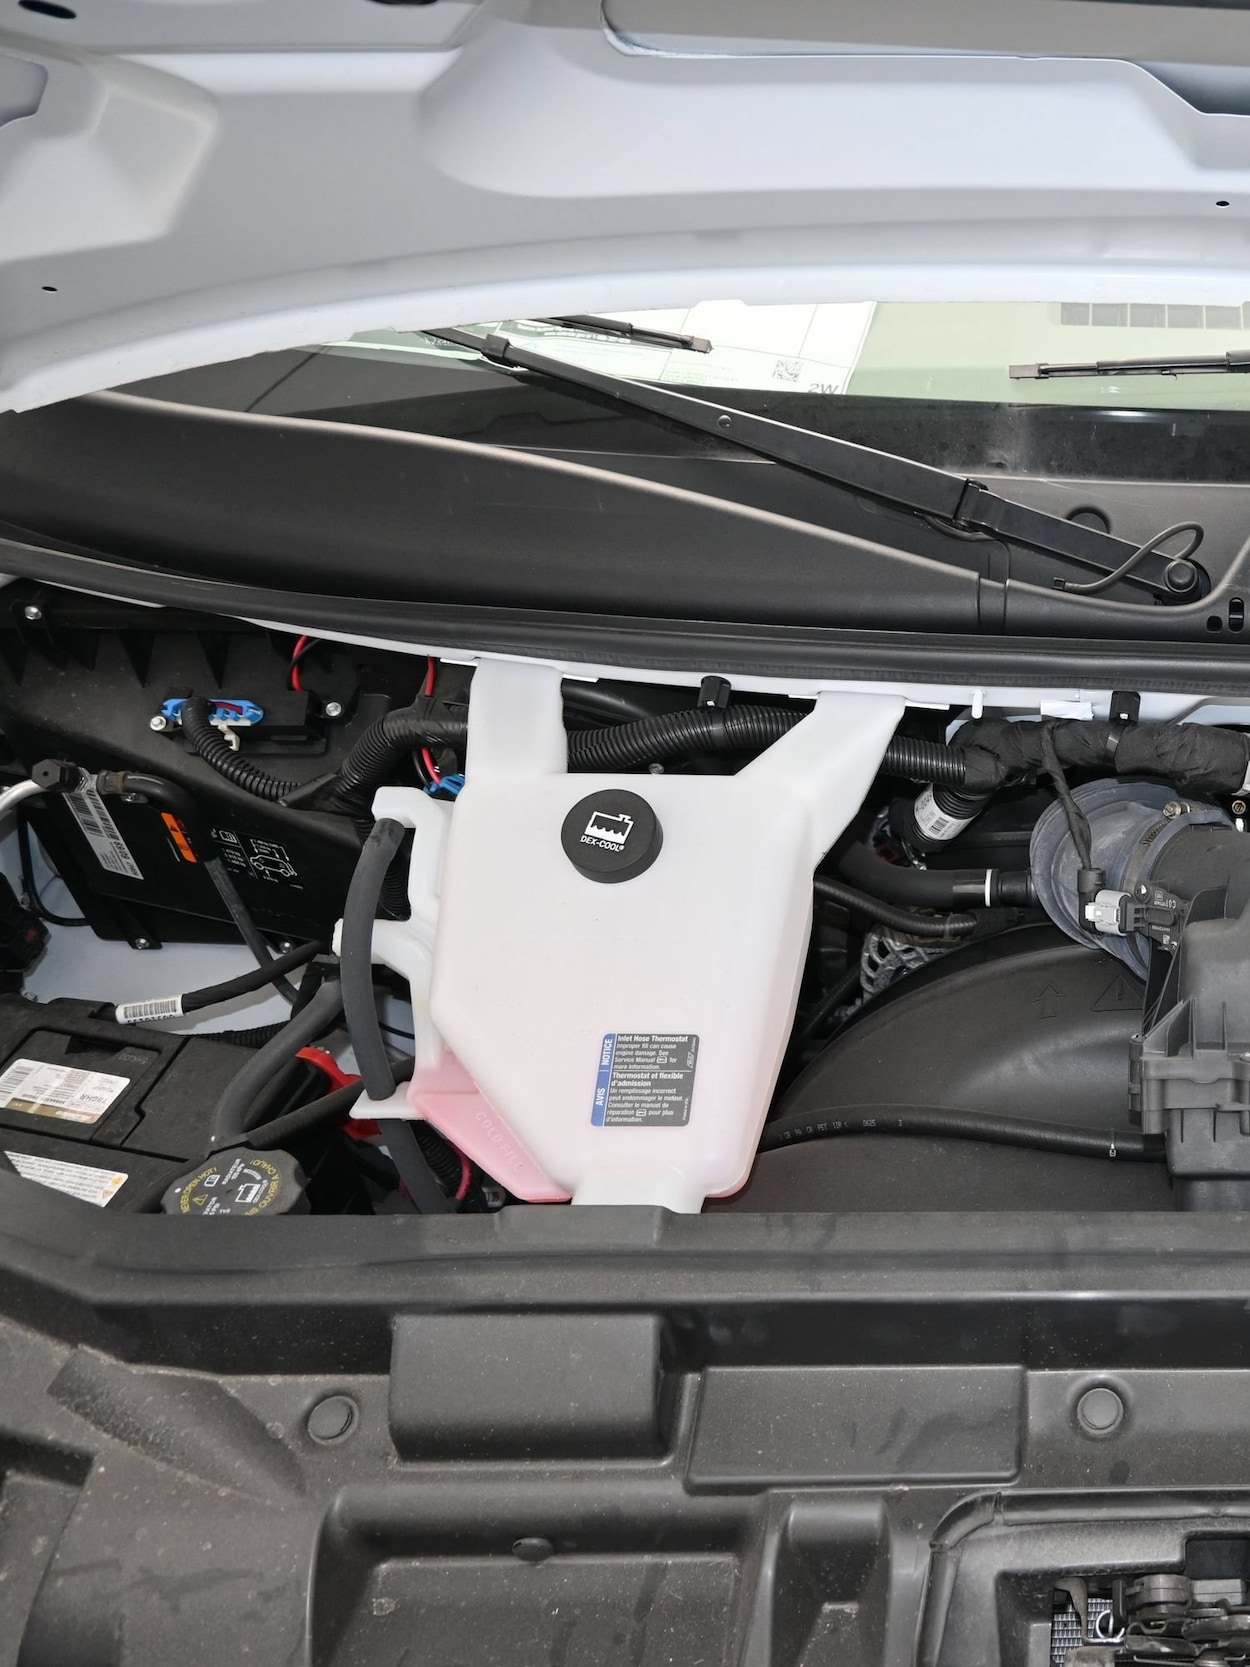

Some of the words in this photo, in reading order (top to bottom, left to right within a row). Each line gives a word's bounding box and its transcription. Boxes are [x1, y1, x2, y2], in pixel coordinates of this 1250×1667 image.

[652, 1035, 689, 1043] Thermostat
[601, 1038, 613, 1066] NOTICE
[611, 1079, 652, 1087] d'admission
[595, 1087, 606, 1106] AVIS
[475, 1111, 504, 1142] COLD
